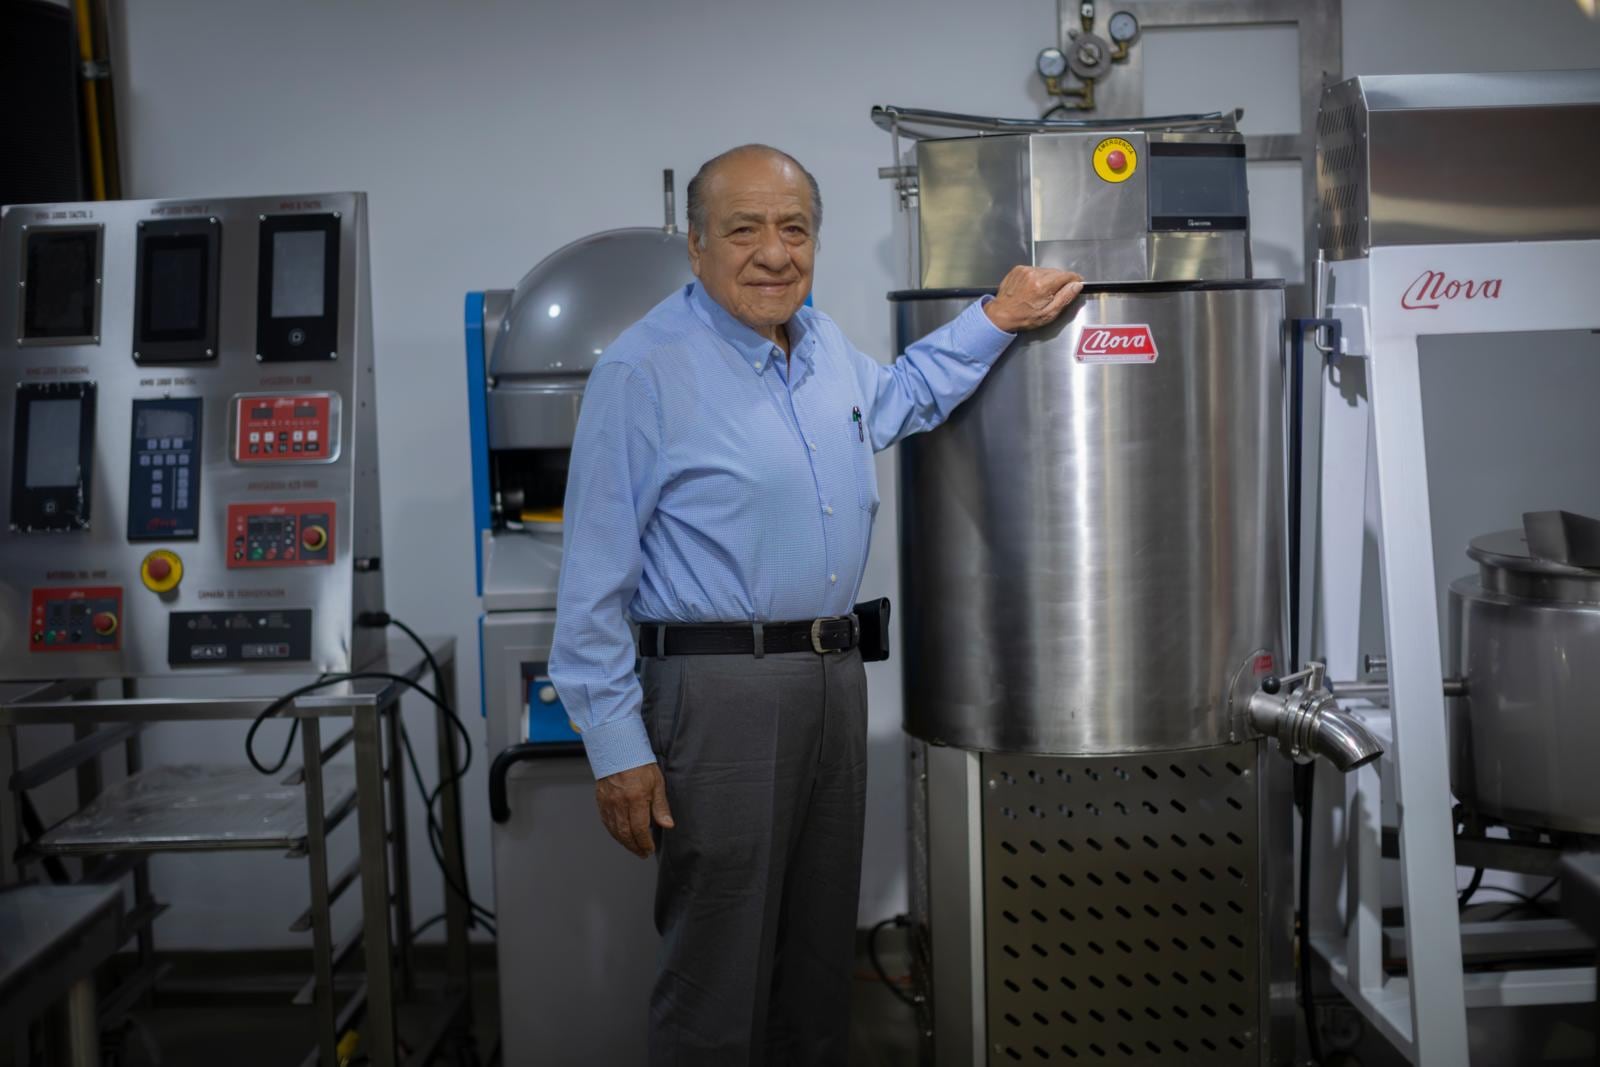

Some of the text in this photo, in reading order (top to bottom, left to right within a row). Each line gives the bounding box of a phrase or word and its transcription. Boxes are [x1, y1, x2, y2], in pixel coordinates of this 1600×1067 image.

[1097, 139, 1134, 155] EMERGENCIA
[1400, 270, 1503, 310] Nova
[1082, 330, 1146, 354] Nova
